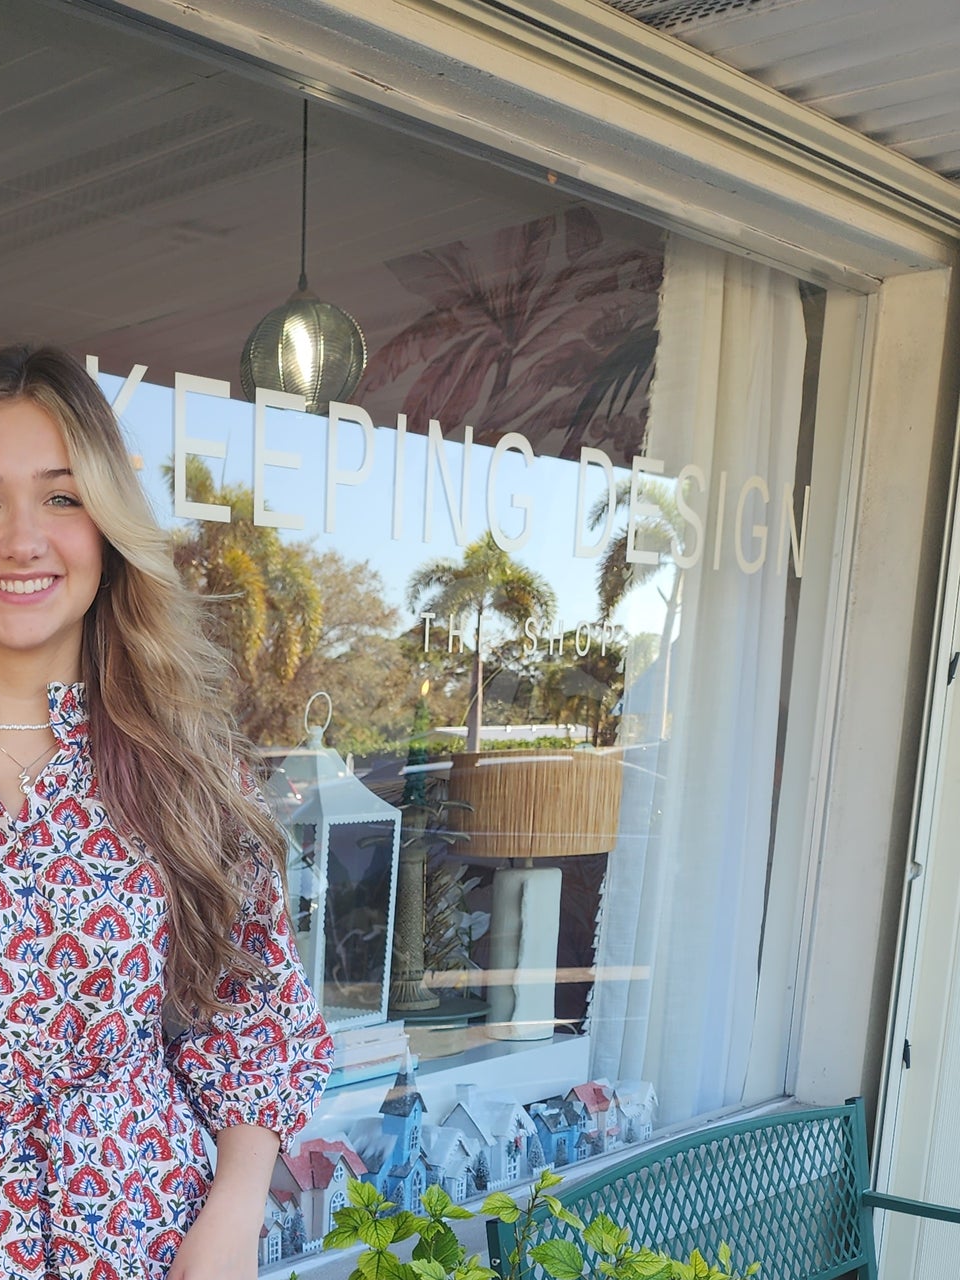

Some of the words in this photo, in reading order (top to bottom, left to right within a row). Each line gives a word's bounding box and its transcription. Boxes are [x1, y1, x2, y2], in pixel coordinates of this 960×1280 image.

[573, 446, 811, 579] DESIGN
[419, 611, 493, 654] THE
[523, 617, 616, 657] SHOP
